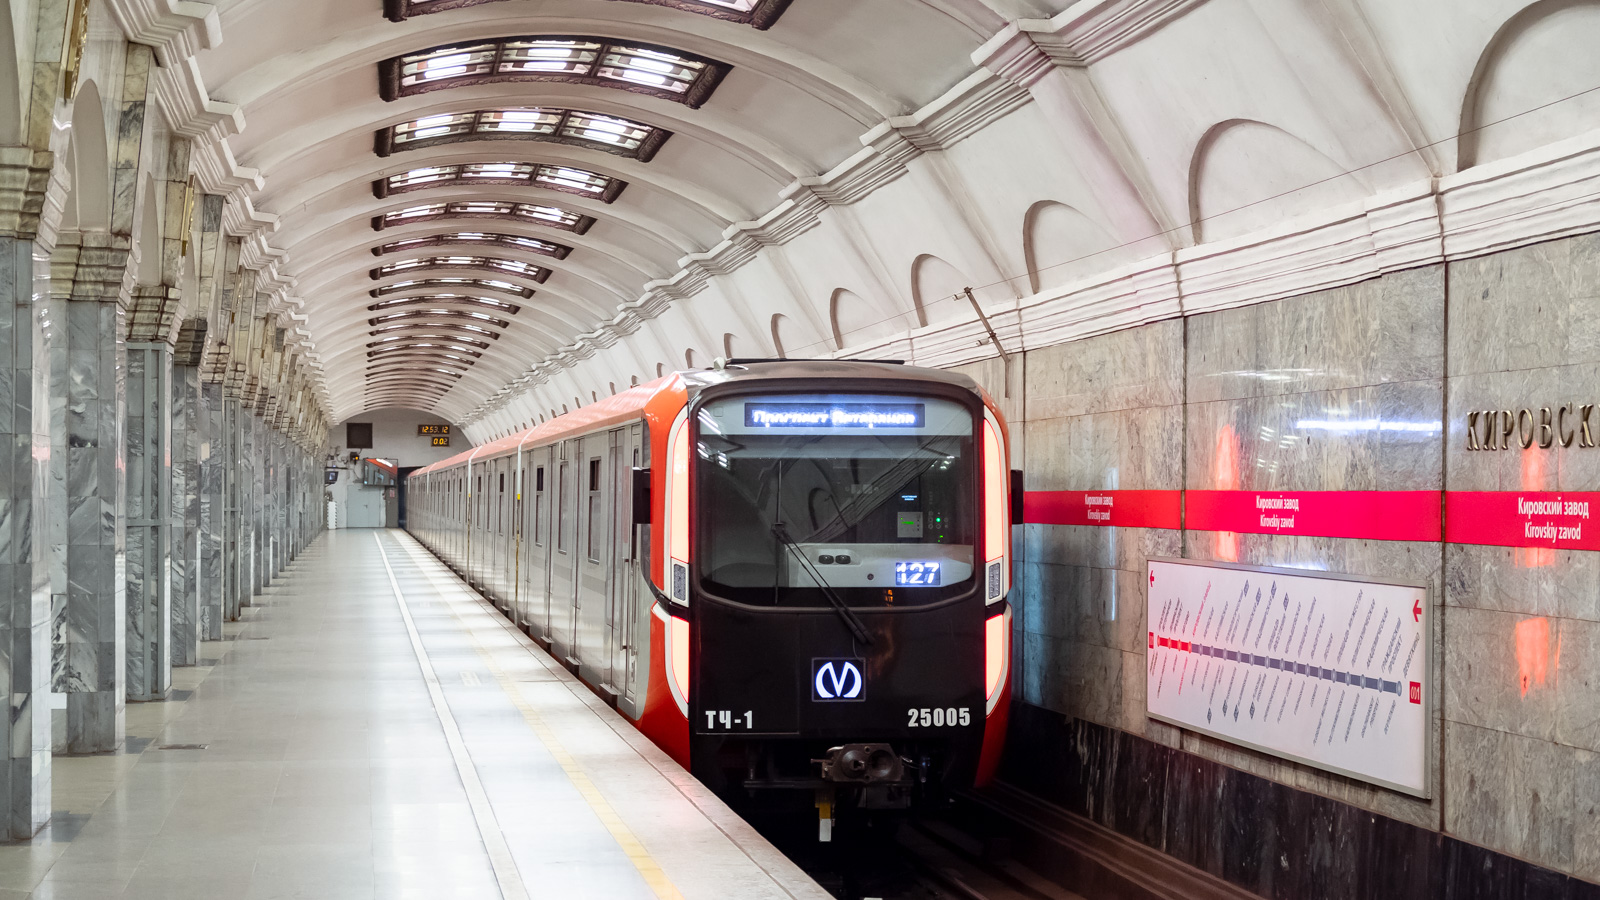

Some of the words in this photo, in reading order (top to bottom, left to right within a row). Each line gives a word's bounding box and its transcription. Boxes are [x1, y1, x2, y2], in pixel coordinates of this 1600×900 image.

[1467, 402, 1600, 451] КИРОВСК
[1256, 495, 1283, 512] Кировский
[1284, 498, 1299, 512] завод
[1518, 497, 1562, 519] Кировский
[1564, 501, 1589, 519] завод
[1281, 514, 1294, 528] zavod
[1525, 522, 1557, 543] Kirovskiy
[1559, 523, 1581, 540] zavod
[896, 563, 939, 584] 127
[705, 710, 753, 729] ТЧ-1
[907, 707, 971, 728] 25005
